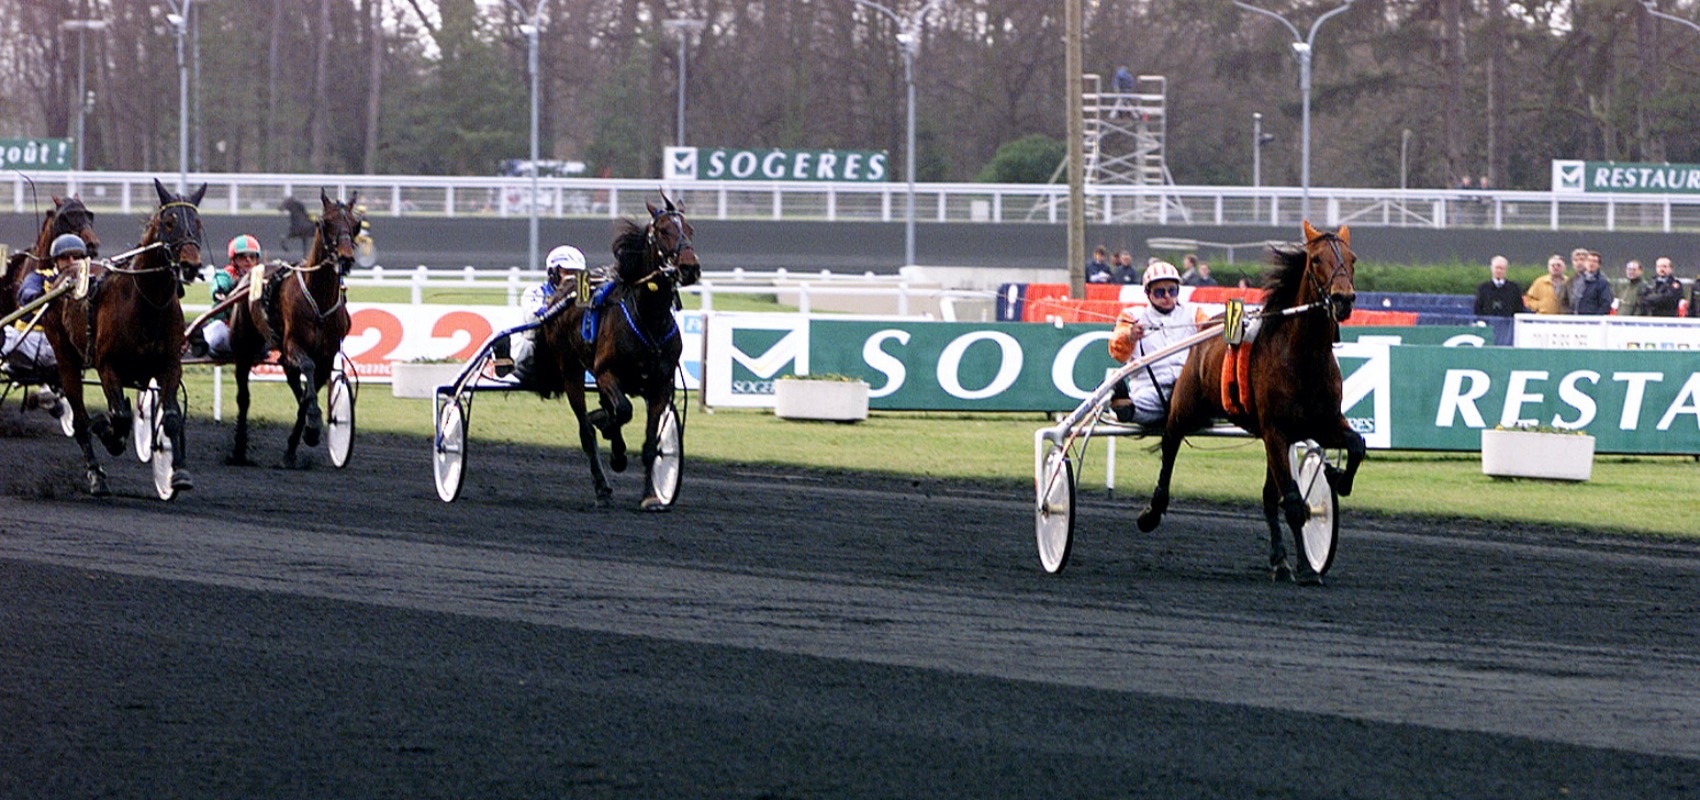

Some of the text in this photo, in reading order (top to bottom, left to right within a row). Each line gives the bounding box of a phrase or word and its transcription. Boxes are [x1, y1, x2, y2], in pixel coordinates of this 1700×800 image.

[706, 150, 887, 180] SOGERES
[1594, 167, 1700, 189] RESTAUR
[1226, 300, 1242, 340] 17
[1435, 369, 1700, 431] RESTA
